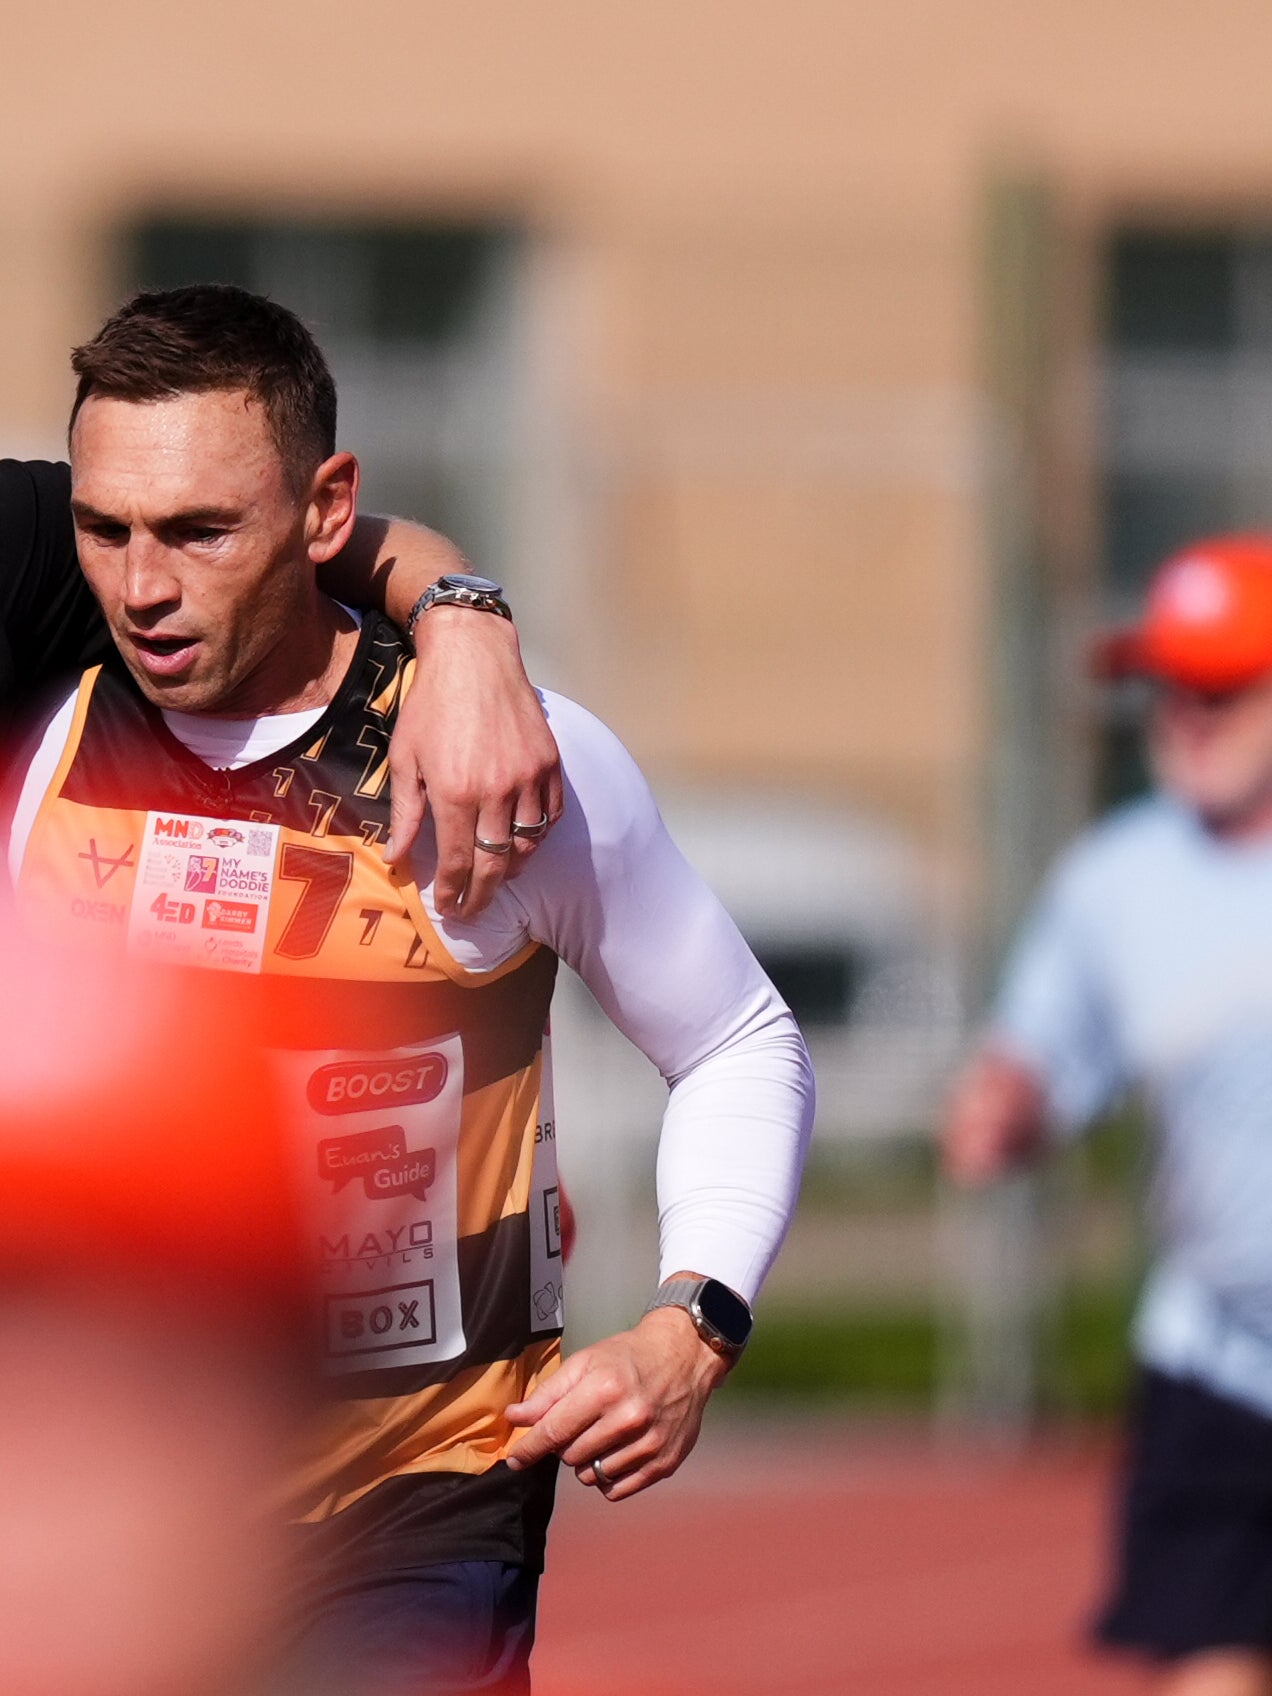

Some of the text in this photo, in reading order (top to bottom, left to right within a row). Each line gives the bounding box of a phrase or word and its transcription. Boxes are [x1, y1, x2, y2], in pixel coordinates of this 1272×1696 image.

[154, 817, 204, 840] MND
[220, 868, 268, 881] NAME'S
[222, 857, 241, 867] MY
[219, 880, 270, 893] DODDIE
[273, 842, 354, 961] 7
[359, 908, 384, 946] 7
[326, 1065, 434, 1102] BOOST
[373, 1162, 430, 1189] Guide
[319, 1220, 433, 1258] MAYO
[340, 1299, 420, 1340] BOX
